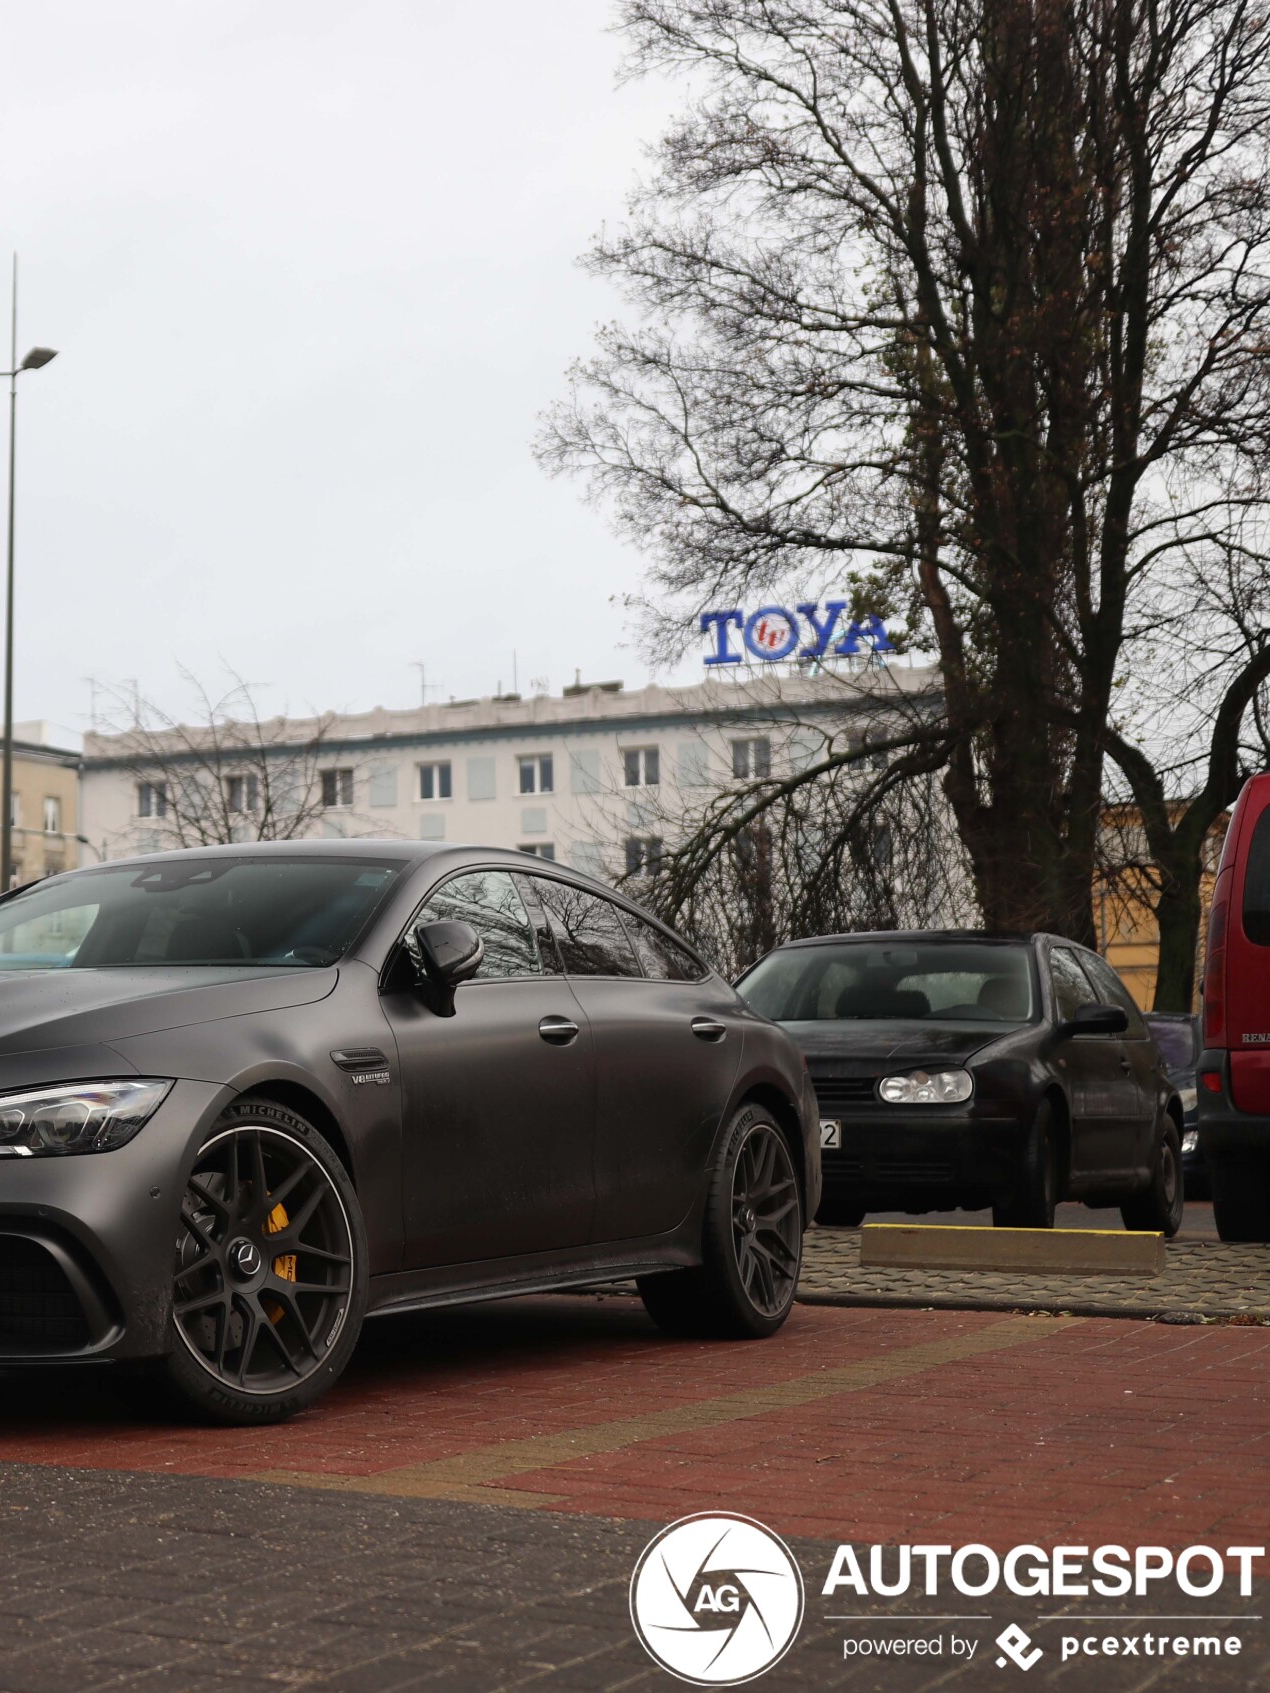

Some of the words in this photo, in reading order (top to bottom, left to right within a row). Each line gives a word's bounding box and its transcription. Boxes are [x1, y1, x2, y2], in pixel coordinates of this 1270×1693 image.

[700, 600, 896, 664] TOYA
[240, 1105, 306, 1132] MICHELIN
[819, 1124, 837, 1146] 2
